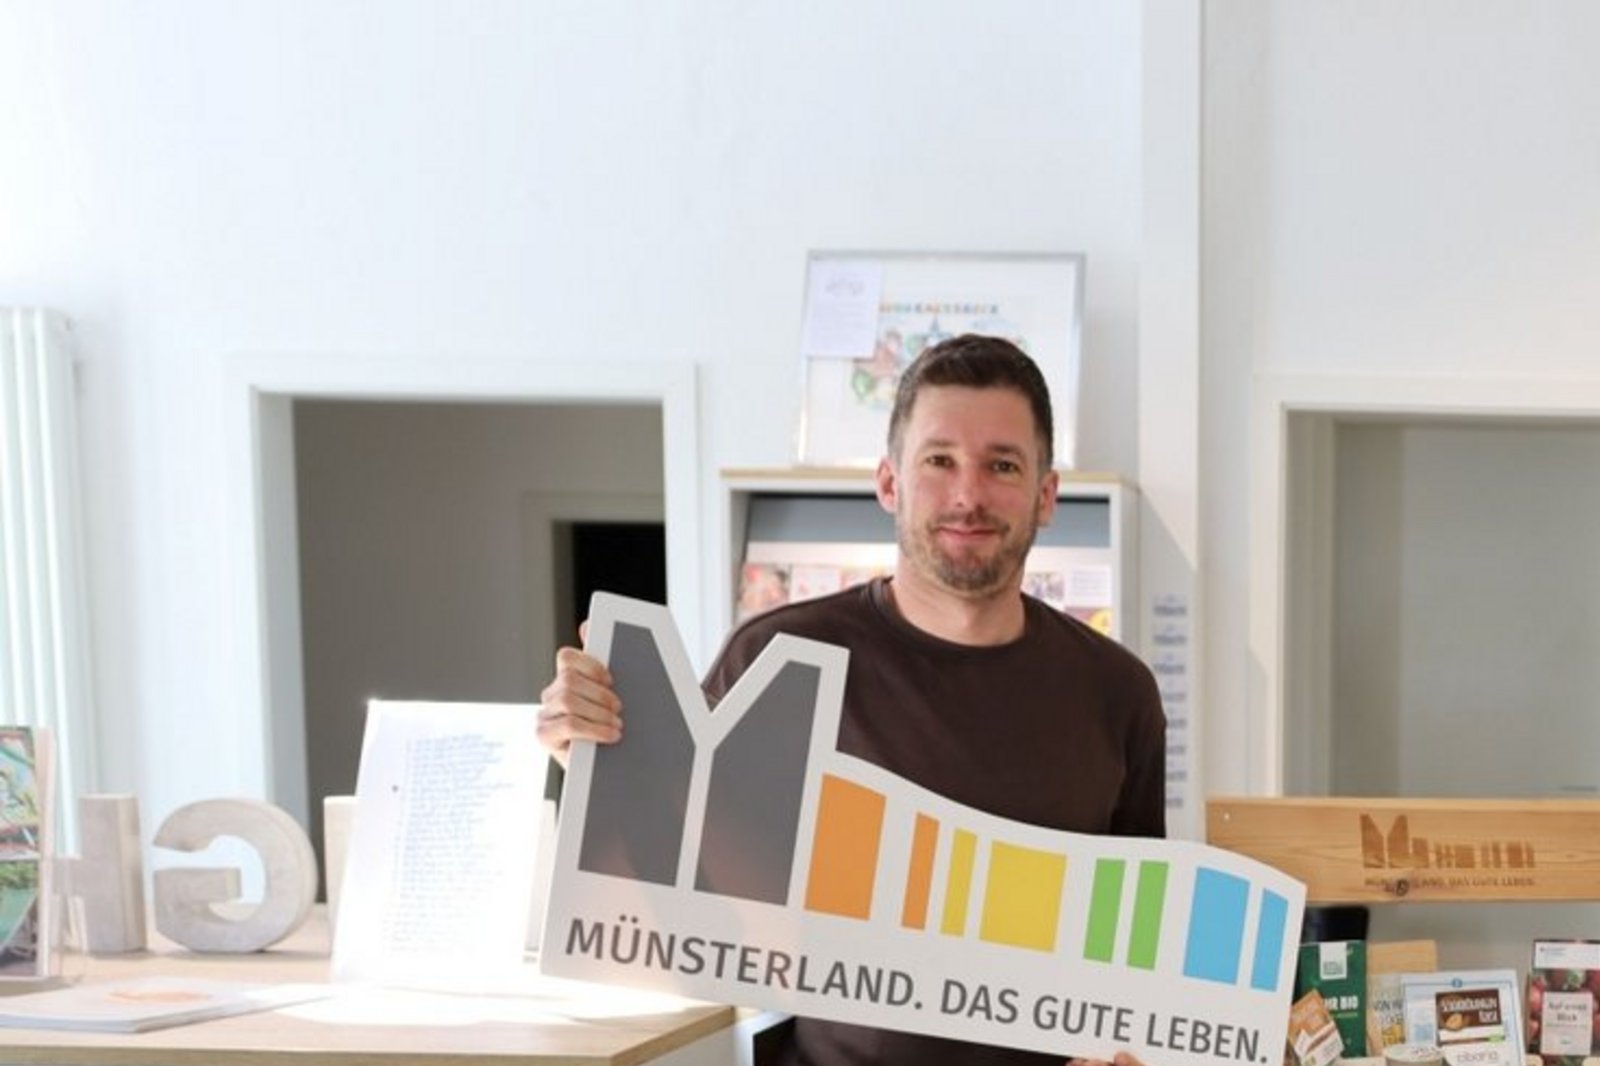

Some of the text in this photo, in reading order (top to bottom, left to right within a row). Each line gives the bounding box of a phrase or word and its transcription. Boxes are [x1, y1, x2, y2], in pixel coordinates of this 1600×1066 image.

[565, 914, 1269, 1065] MÜNSTERLAND. DAS GUTE LEBEN.
